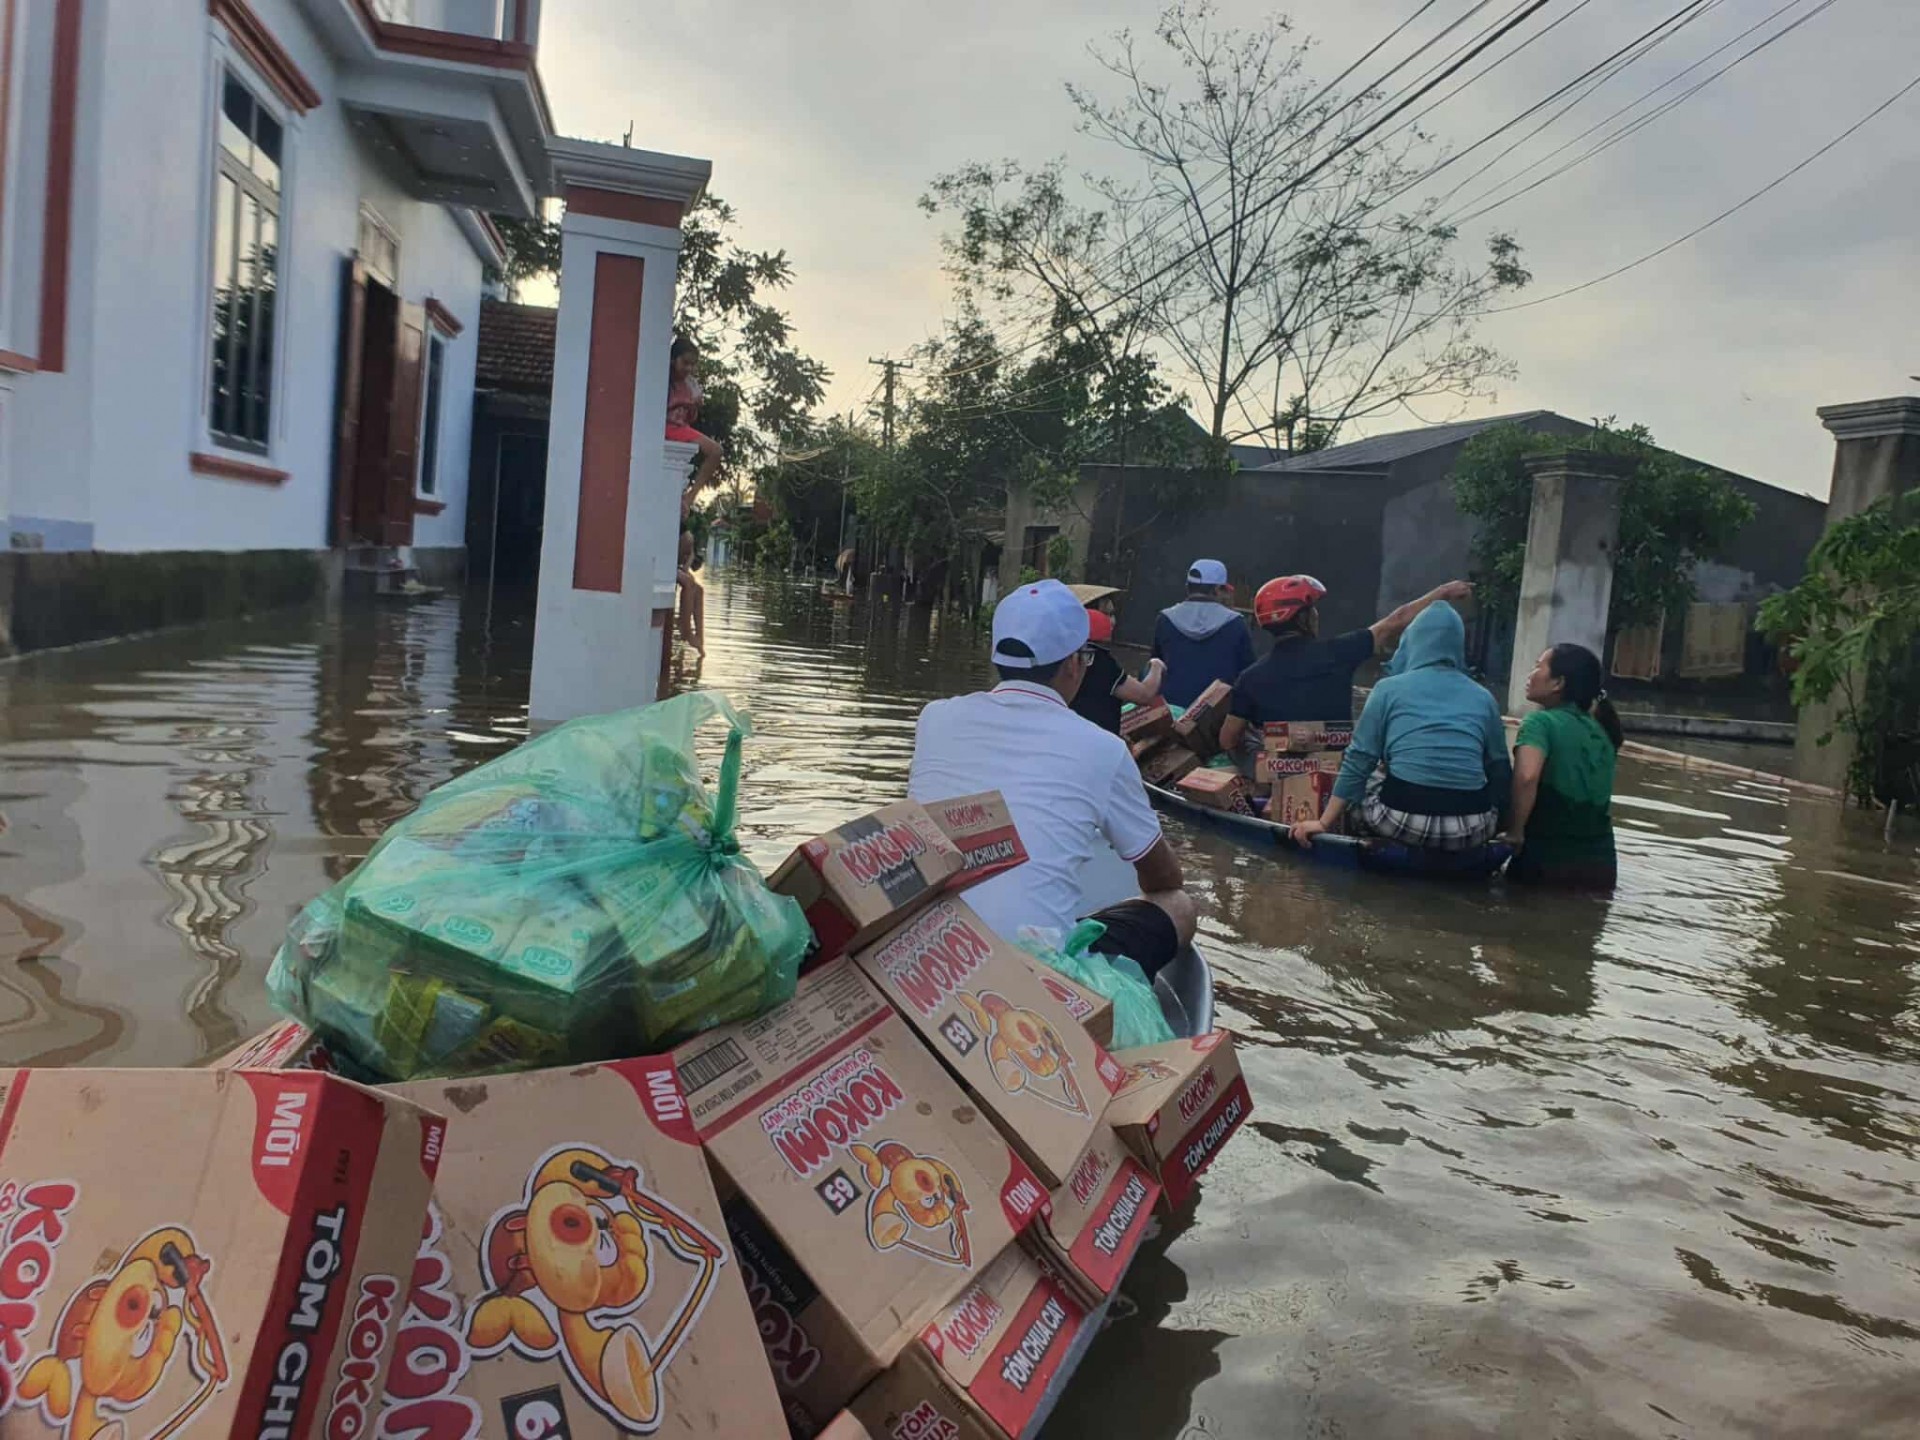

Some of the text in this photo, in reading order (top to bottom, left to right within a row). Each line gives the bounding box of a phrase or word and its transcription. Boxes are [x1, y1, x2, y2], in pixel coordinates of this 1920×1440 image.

[1267, 759, 1319, 772] KOKOMI
[838, 821, 925, 886] KOKOMI
[893, 917, 992, 1016] KOKOMI
[945, 1019, 974, 1052] 65
[646, 1069, 687, 1122] MỚI
[825, 1058, 860, 1086] KOKOMI
[260, 1091, 308, 1168] MỚI
[773, 1064, 904, 1176] KOKOMI
[1202, 1116, 1229, 1152] CHUA
[1225, 1095, 1243, 1124] CAY
[824, 1175, 855, 1209] 65
[1110, 1193, 1134, 1231] CHUA
[1129, 1175, 1147, 1207] CAY
[288, 1206, 346, 1329] TÔM
[1002, 1353, 1029, 1392] TÔM
[1021, 1322, 1050, 1366] CHUA
[1040, 1296, 1066, 1332] CAY
[894, 1401, 936, 1440] TÔM
